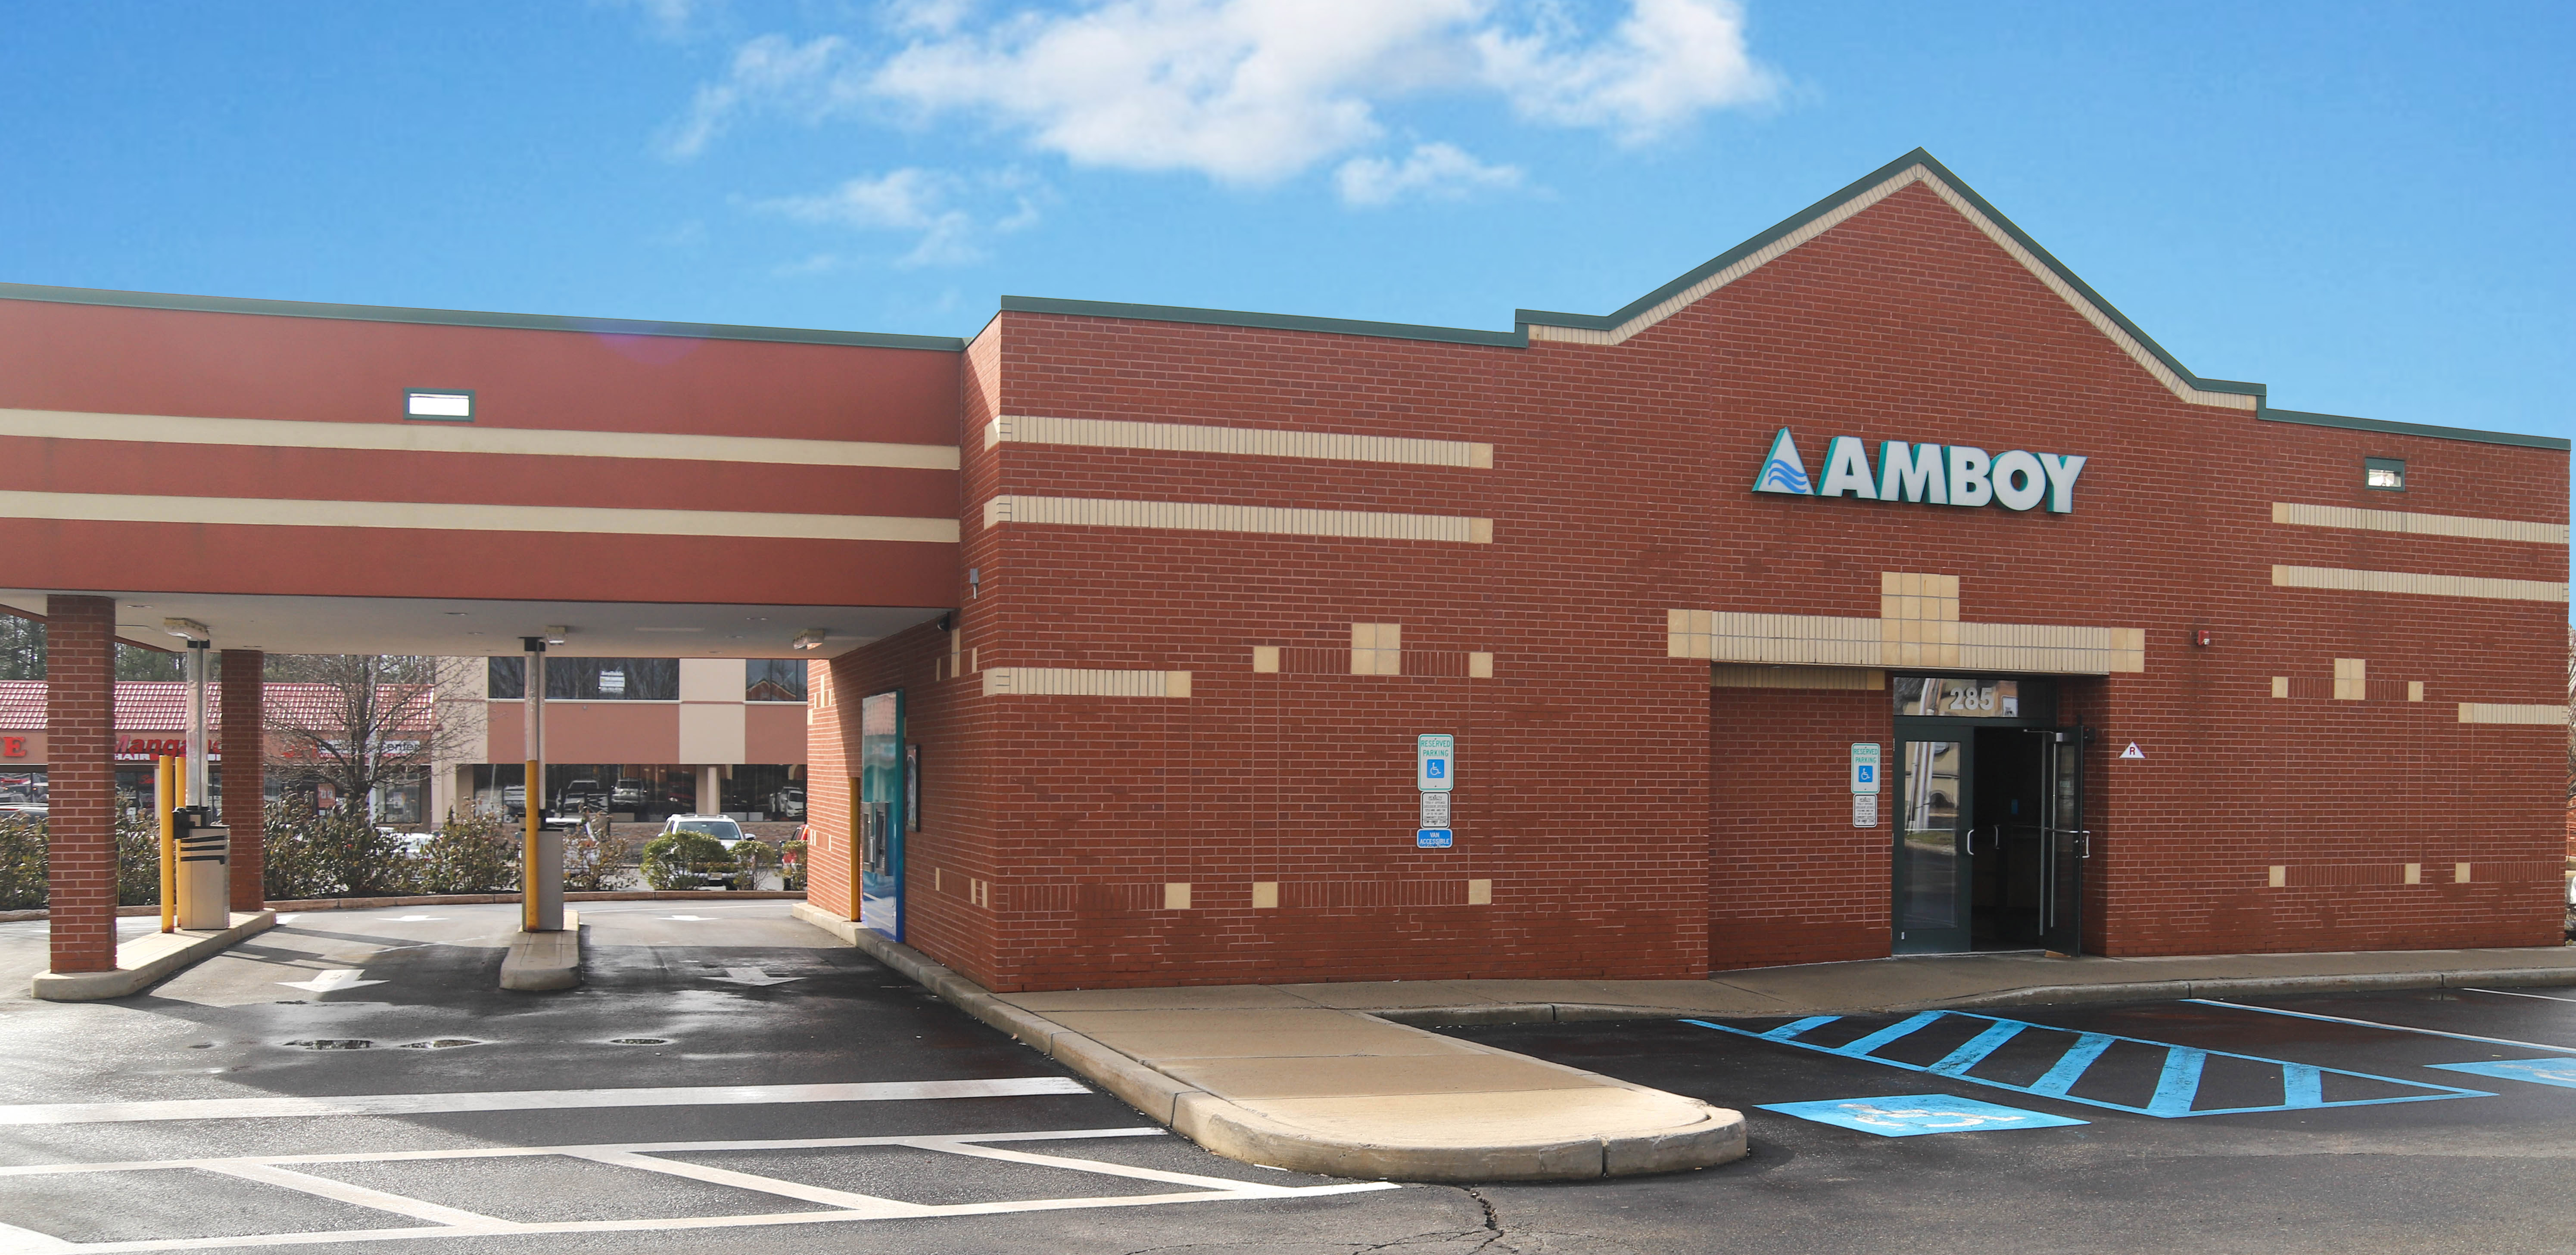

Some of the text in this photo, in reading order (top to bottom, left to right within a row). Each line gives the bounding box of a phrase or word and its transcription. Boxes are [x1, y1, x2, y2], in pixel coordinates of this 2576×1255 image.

[1816, 435, 2088, 513] AMBOY
[1950, 687, 1995, 710] 285
[2130, 747, 2136, 755] R
